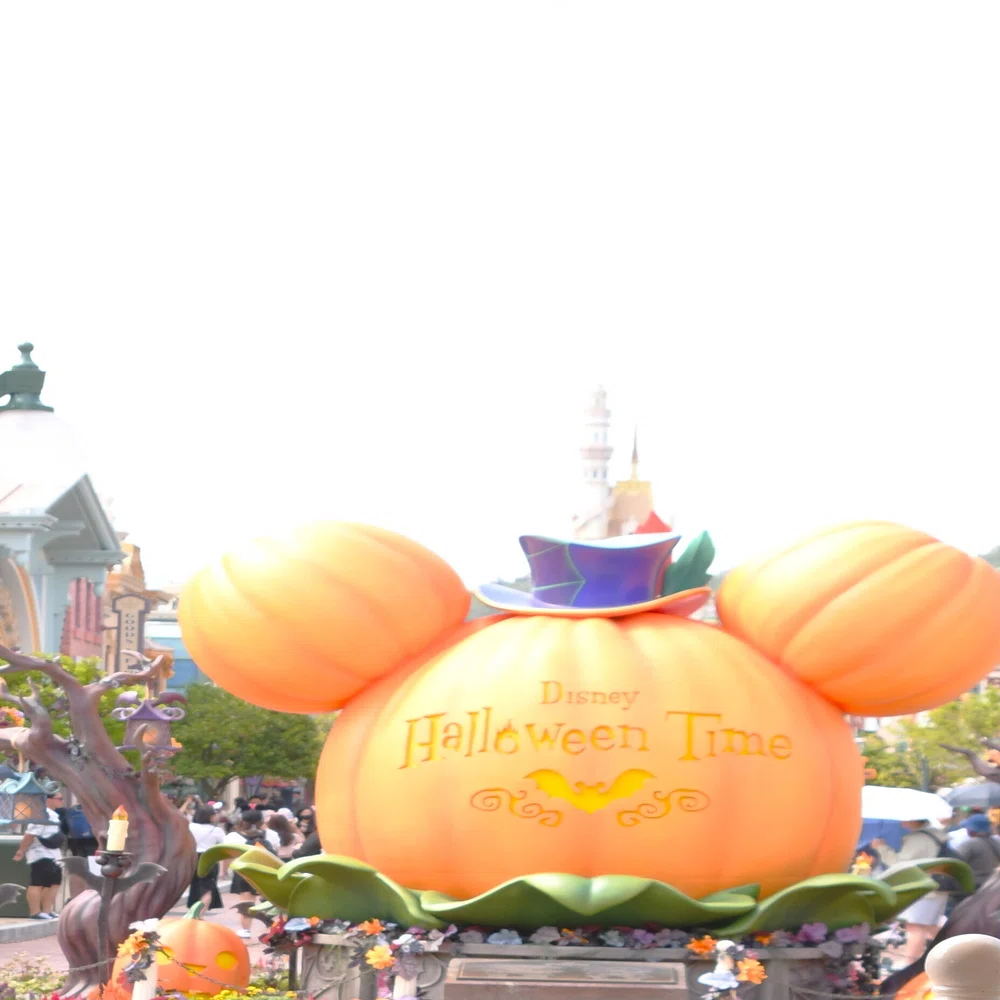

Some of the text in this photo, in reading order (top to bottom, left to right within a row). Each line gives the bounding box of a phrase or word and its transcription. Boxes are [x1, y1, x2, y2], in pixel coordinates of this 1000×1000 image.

[539, 680, 640, 711] Disney
[398, 706, 793, 769] Halloween Time
